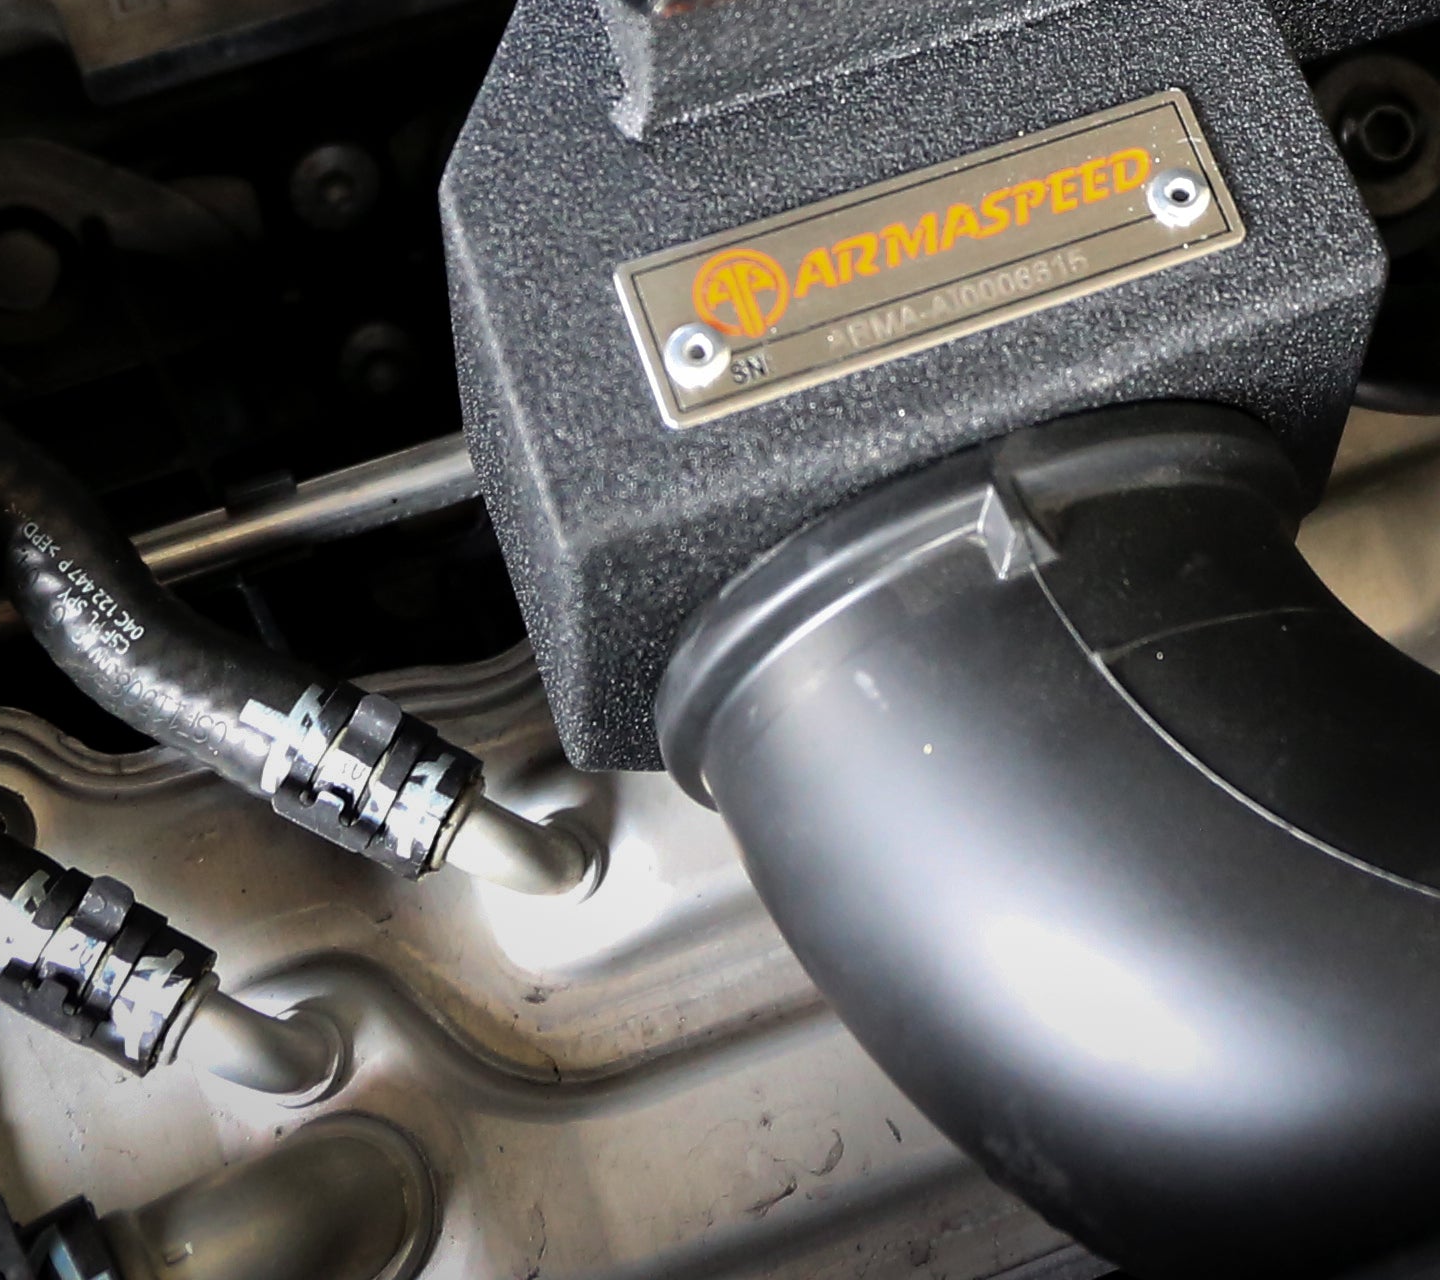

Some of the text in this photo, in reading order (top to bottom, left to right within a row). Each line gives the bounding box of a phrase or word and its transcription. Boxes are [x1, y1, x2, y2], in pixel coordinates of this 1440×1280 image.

[792, 145, 1152, 300] ARMASPEED
[54, 554, 74, 573] P
[65, 565, 97, 596] 447
[55, 585, 87, 615] SPY
[88, 586, 120, 618] 122
[98, 625, 131, 657] CSF
[112, 609, 146, 642] 04C
